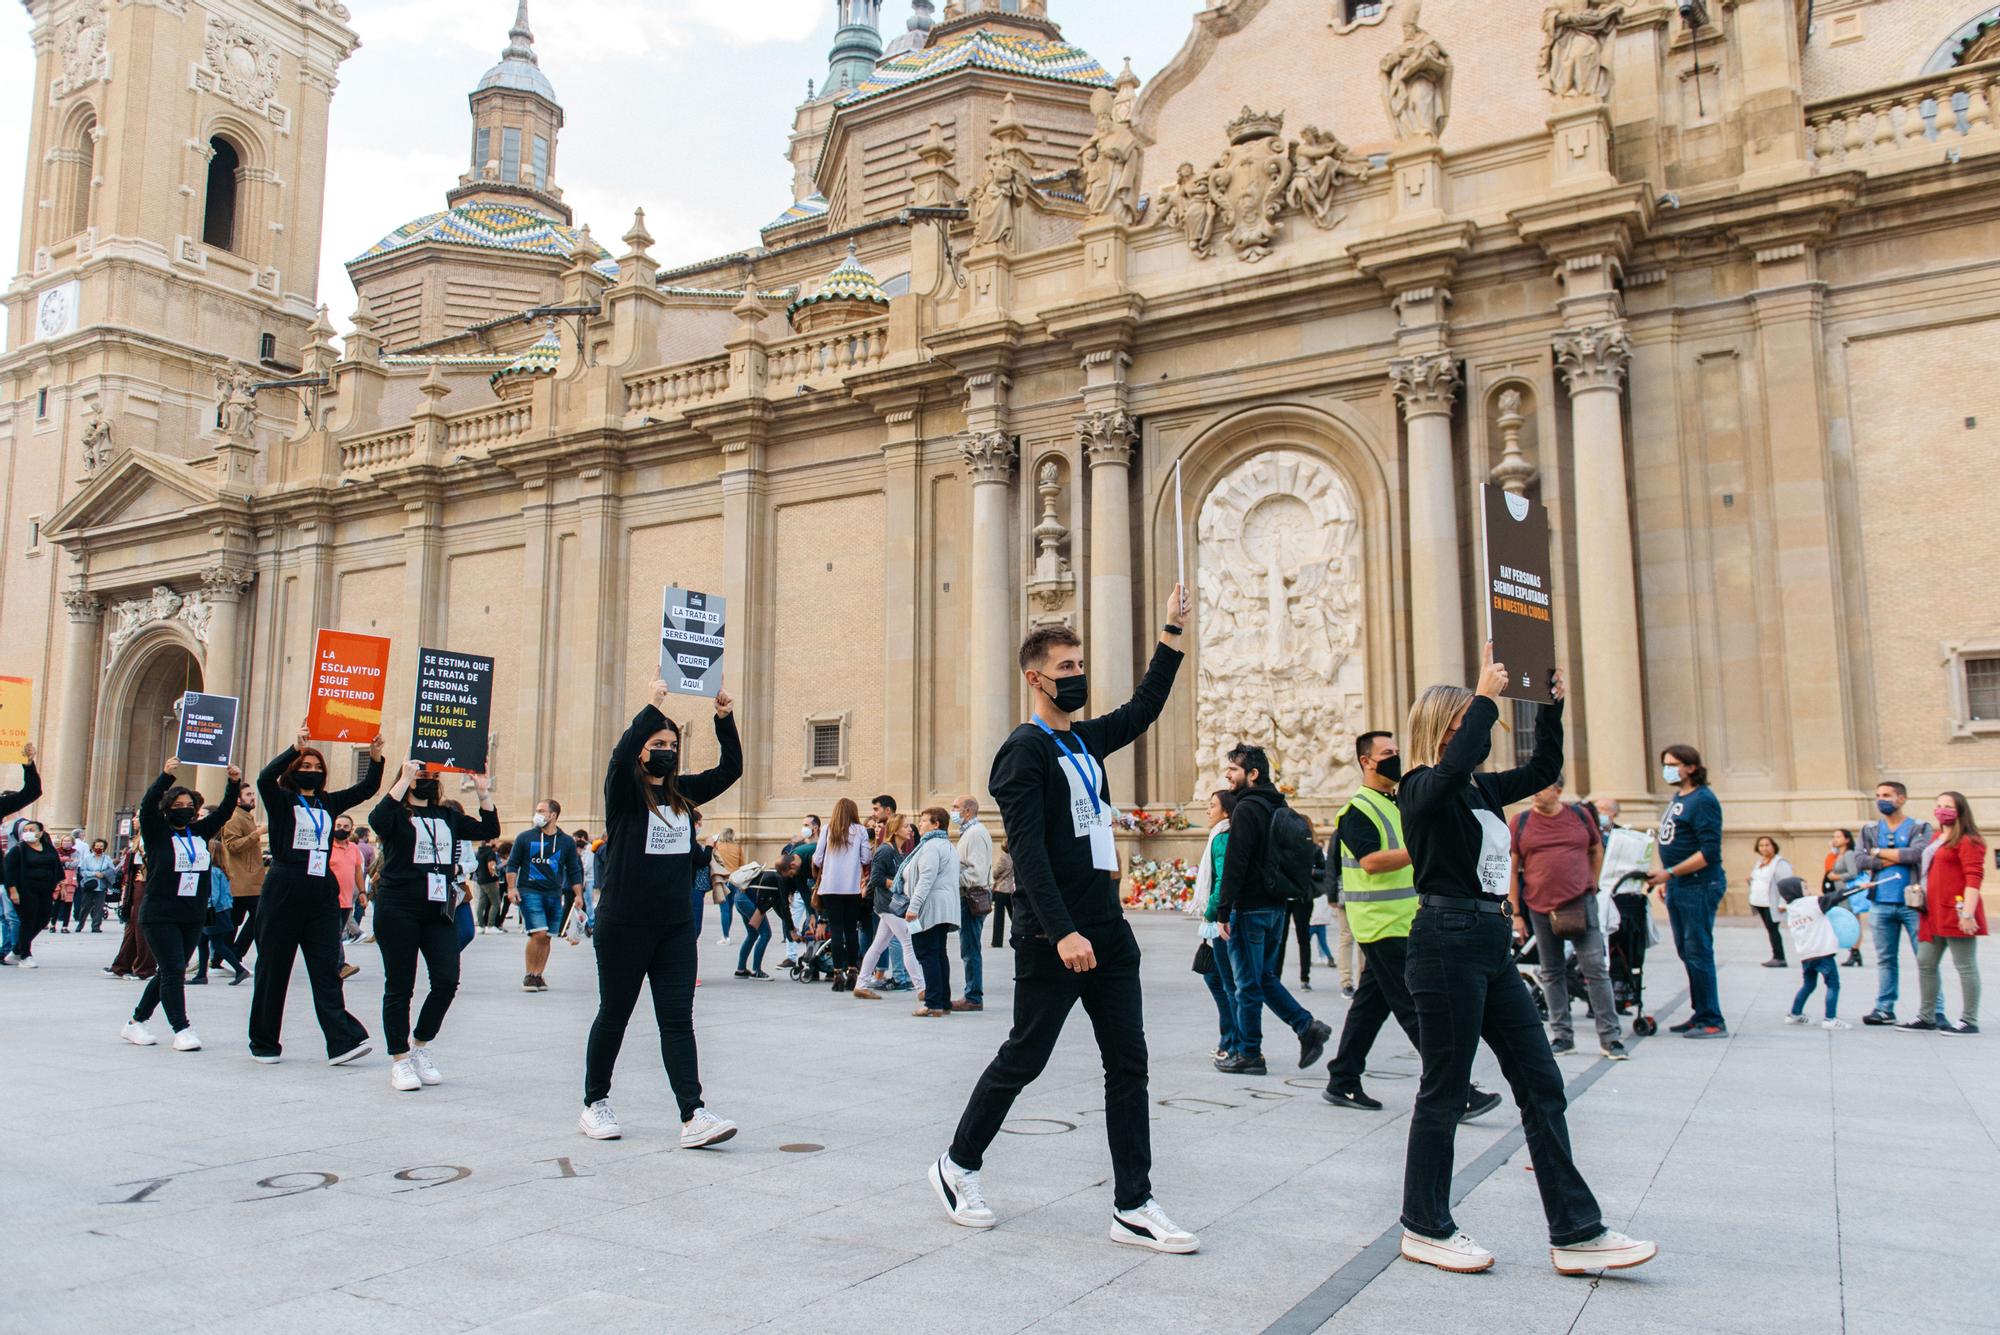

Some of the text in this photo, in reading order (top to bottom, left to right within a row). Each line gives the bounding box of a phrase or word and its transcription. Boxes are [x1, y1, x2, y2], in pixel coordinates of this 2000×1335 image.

[1500, 565, 1541, 588] HAY PERSONAS
[1494, 580, 1548, 606] SIENDO EXPLOTADAS
[1494, 596, 1502, 609] EN
[1503, 598, 1528, 616] NUESTRA
[685, 610, 706, 620] TRATA
[665, 630, 723, 646] SERES HUMANOS
[322, 650, 335, 659] LA
[680, 656, 708, 666] OCURRE
[321, 662, 380, 676] ESCLAVITUD
[425, 655, 490, 672] SE ESTIMA QUE
[320, 675, 349, 686] SIGUE
[424, 667, 478, 682] LA TRATA DE
[422, 679, 469, 692] PERSONAS
[318, 688, 375, 700] EXISTIENDO
[422, 691, 478, 705] GENERA MÁS
[421, 703, 468, 716] DE 126 MIL
[419, 716, 476, 728] MILLONES DE
[418, 727, 448, 737] EUROS
[417, 740, 452, 750] AL AÑO.
